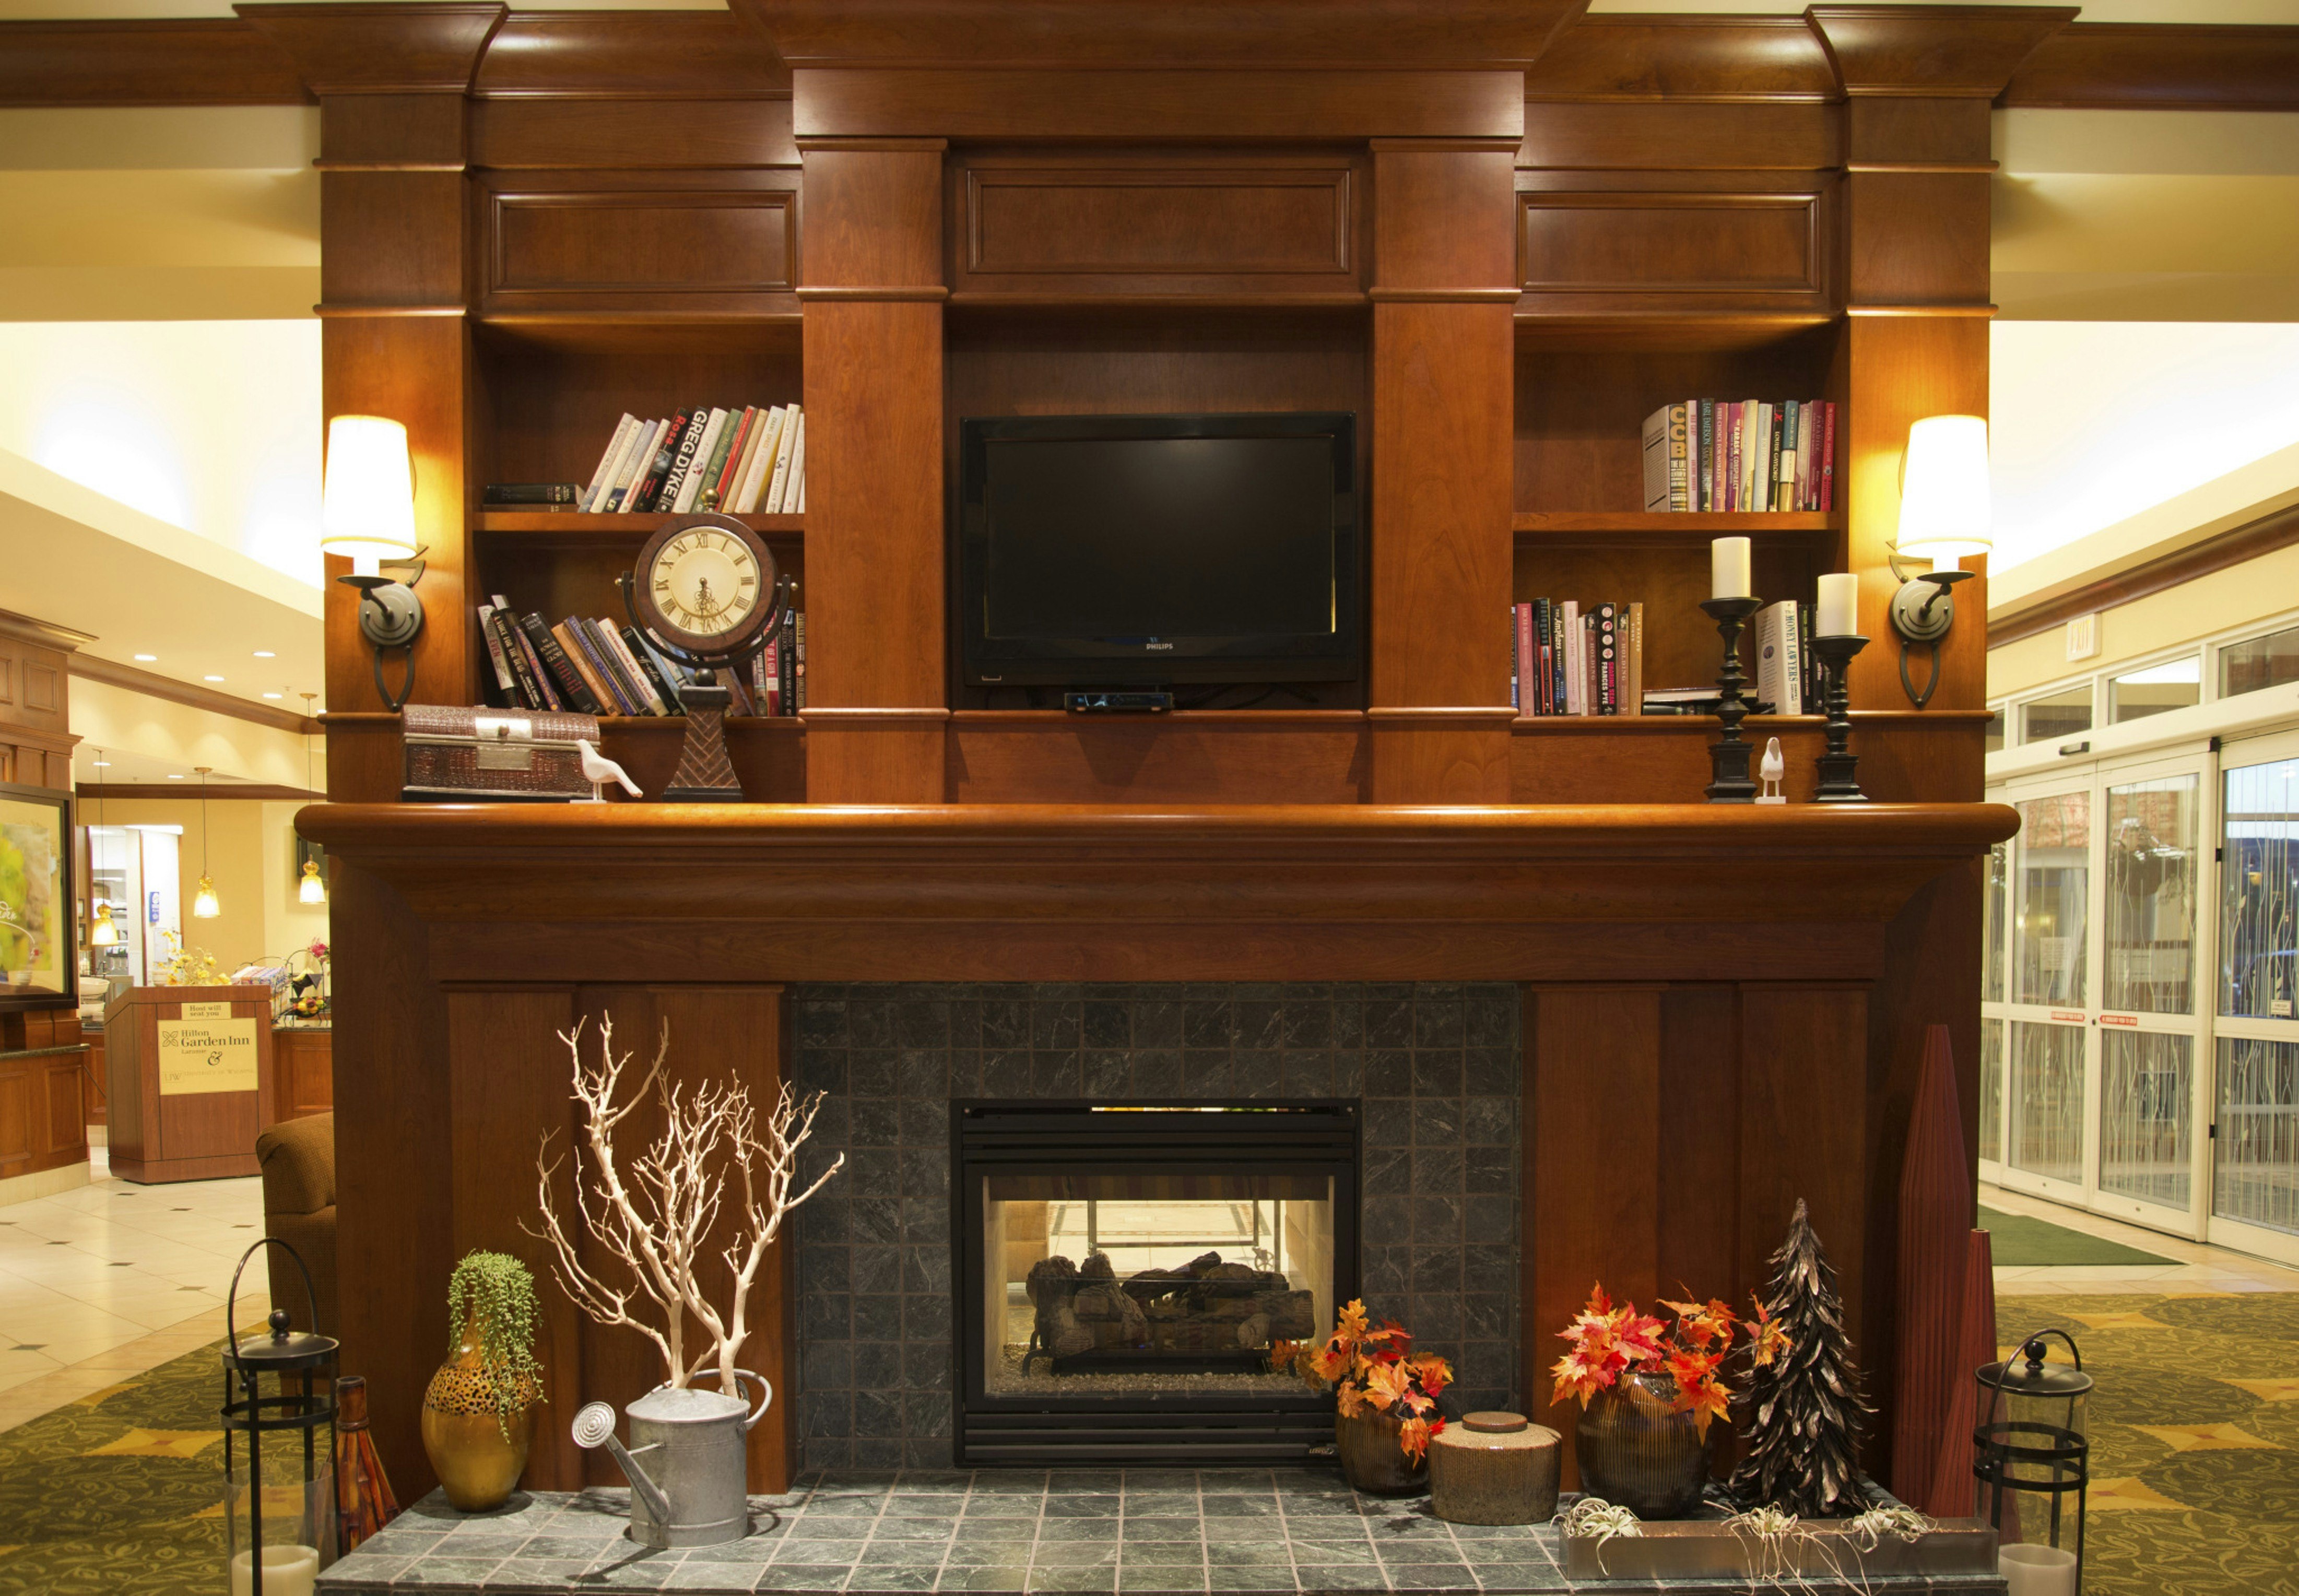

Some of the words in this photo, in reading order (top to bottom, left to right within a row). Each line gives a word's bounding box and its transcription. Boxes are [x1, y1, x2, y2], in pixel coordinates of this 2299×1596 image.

[679, 409, 709, 455] GREG
[1702, 417, 1711, 444] EMERSON
[663, 453, 691, 498] DYKE
[673, 539, 689, 557] XI
[696, 533, 708, 548] XII
[660, 558, 674, 569] X
[734, 554, 747, 566] II
[655, 580, 669, 591] IX
[740, 576, 754, 586] III
[679, 613, 691, 630] VII
[1785, 615, 1796, 642] MONEY
[2070, 619, 2091, 652] EXIT
[584, 642, 600, 664] EMPIRE
[1787, 644, 1797, 681] LAWYERS
[181, 1036, 226, 1047] Garden
[229, 1036, 250, 1045] Inn
[208, 1051, 222, 1066] &
